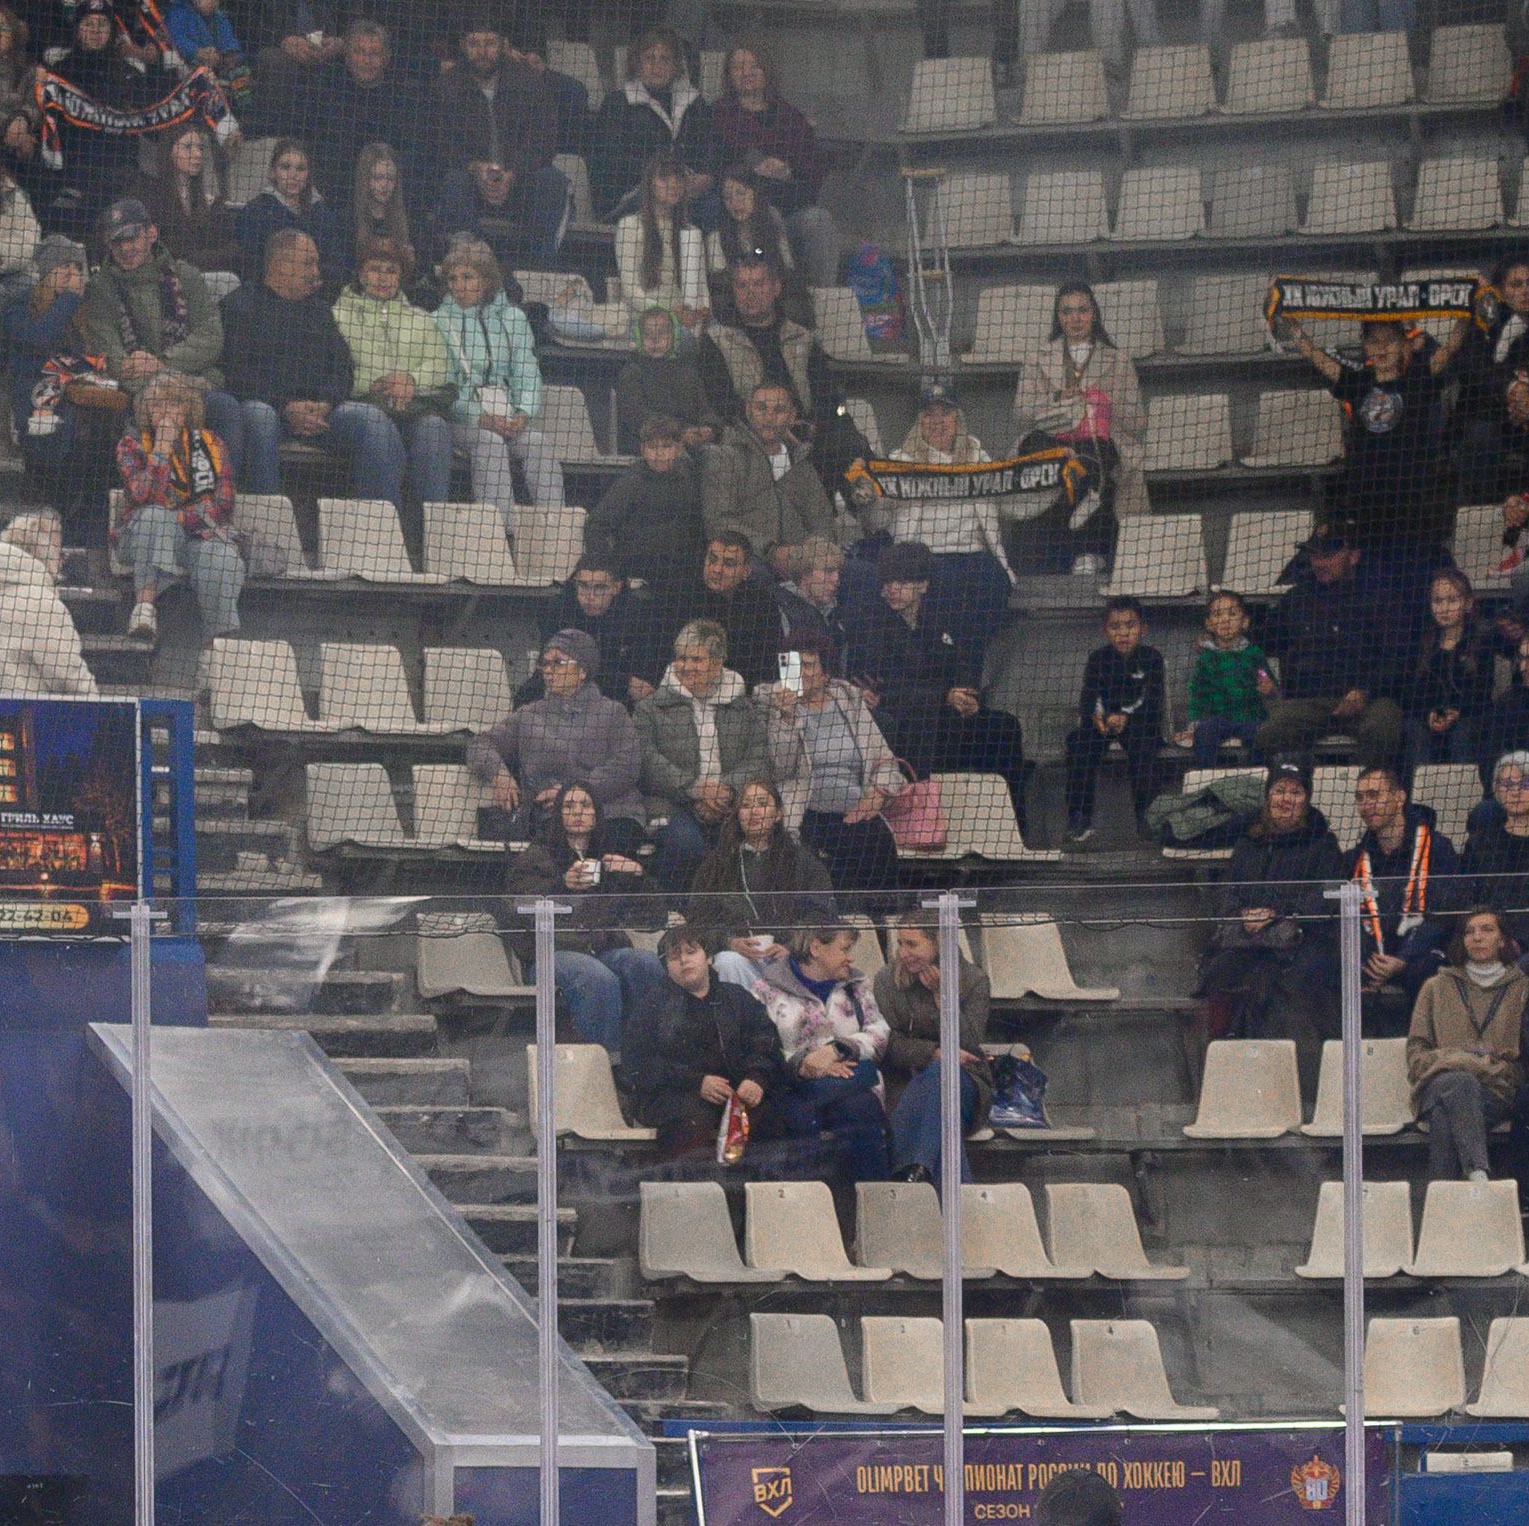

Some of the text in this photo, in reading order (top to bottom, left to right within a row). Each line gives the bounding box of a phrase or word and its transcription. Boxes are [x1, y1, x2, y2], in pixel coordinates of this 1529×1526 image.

[856, 1465, 931, 1493] OLIMPBET
[934, 1463, 1023, 1492] ЧПИОНАТ
[1027, 1461, 1091, 1491] РОСС
[1123, 1460, 1186, 1489] ХОККЕЮ
[1211, 1460, 1242, 1487] ВХЛ
[754, 1478, 793, 1502] ВХЛ
[974, 1504, 1031, 1520] СЕЗОН
